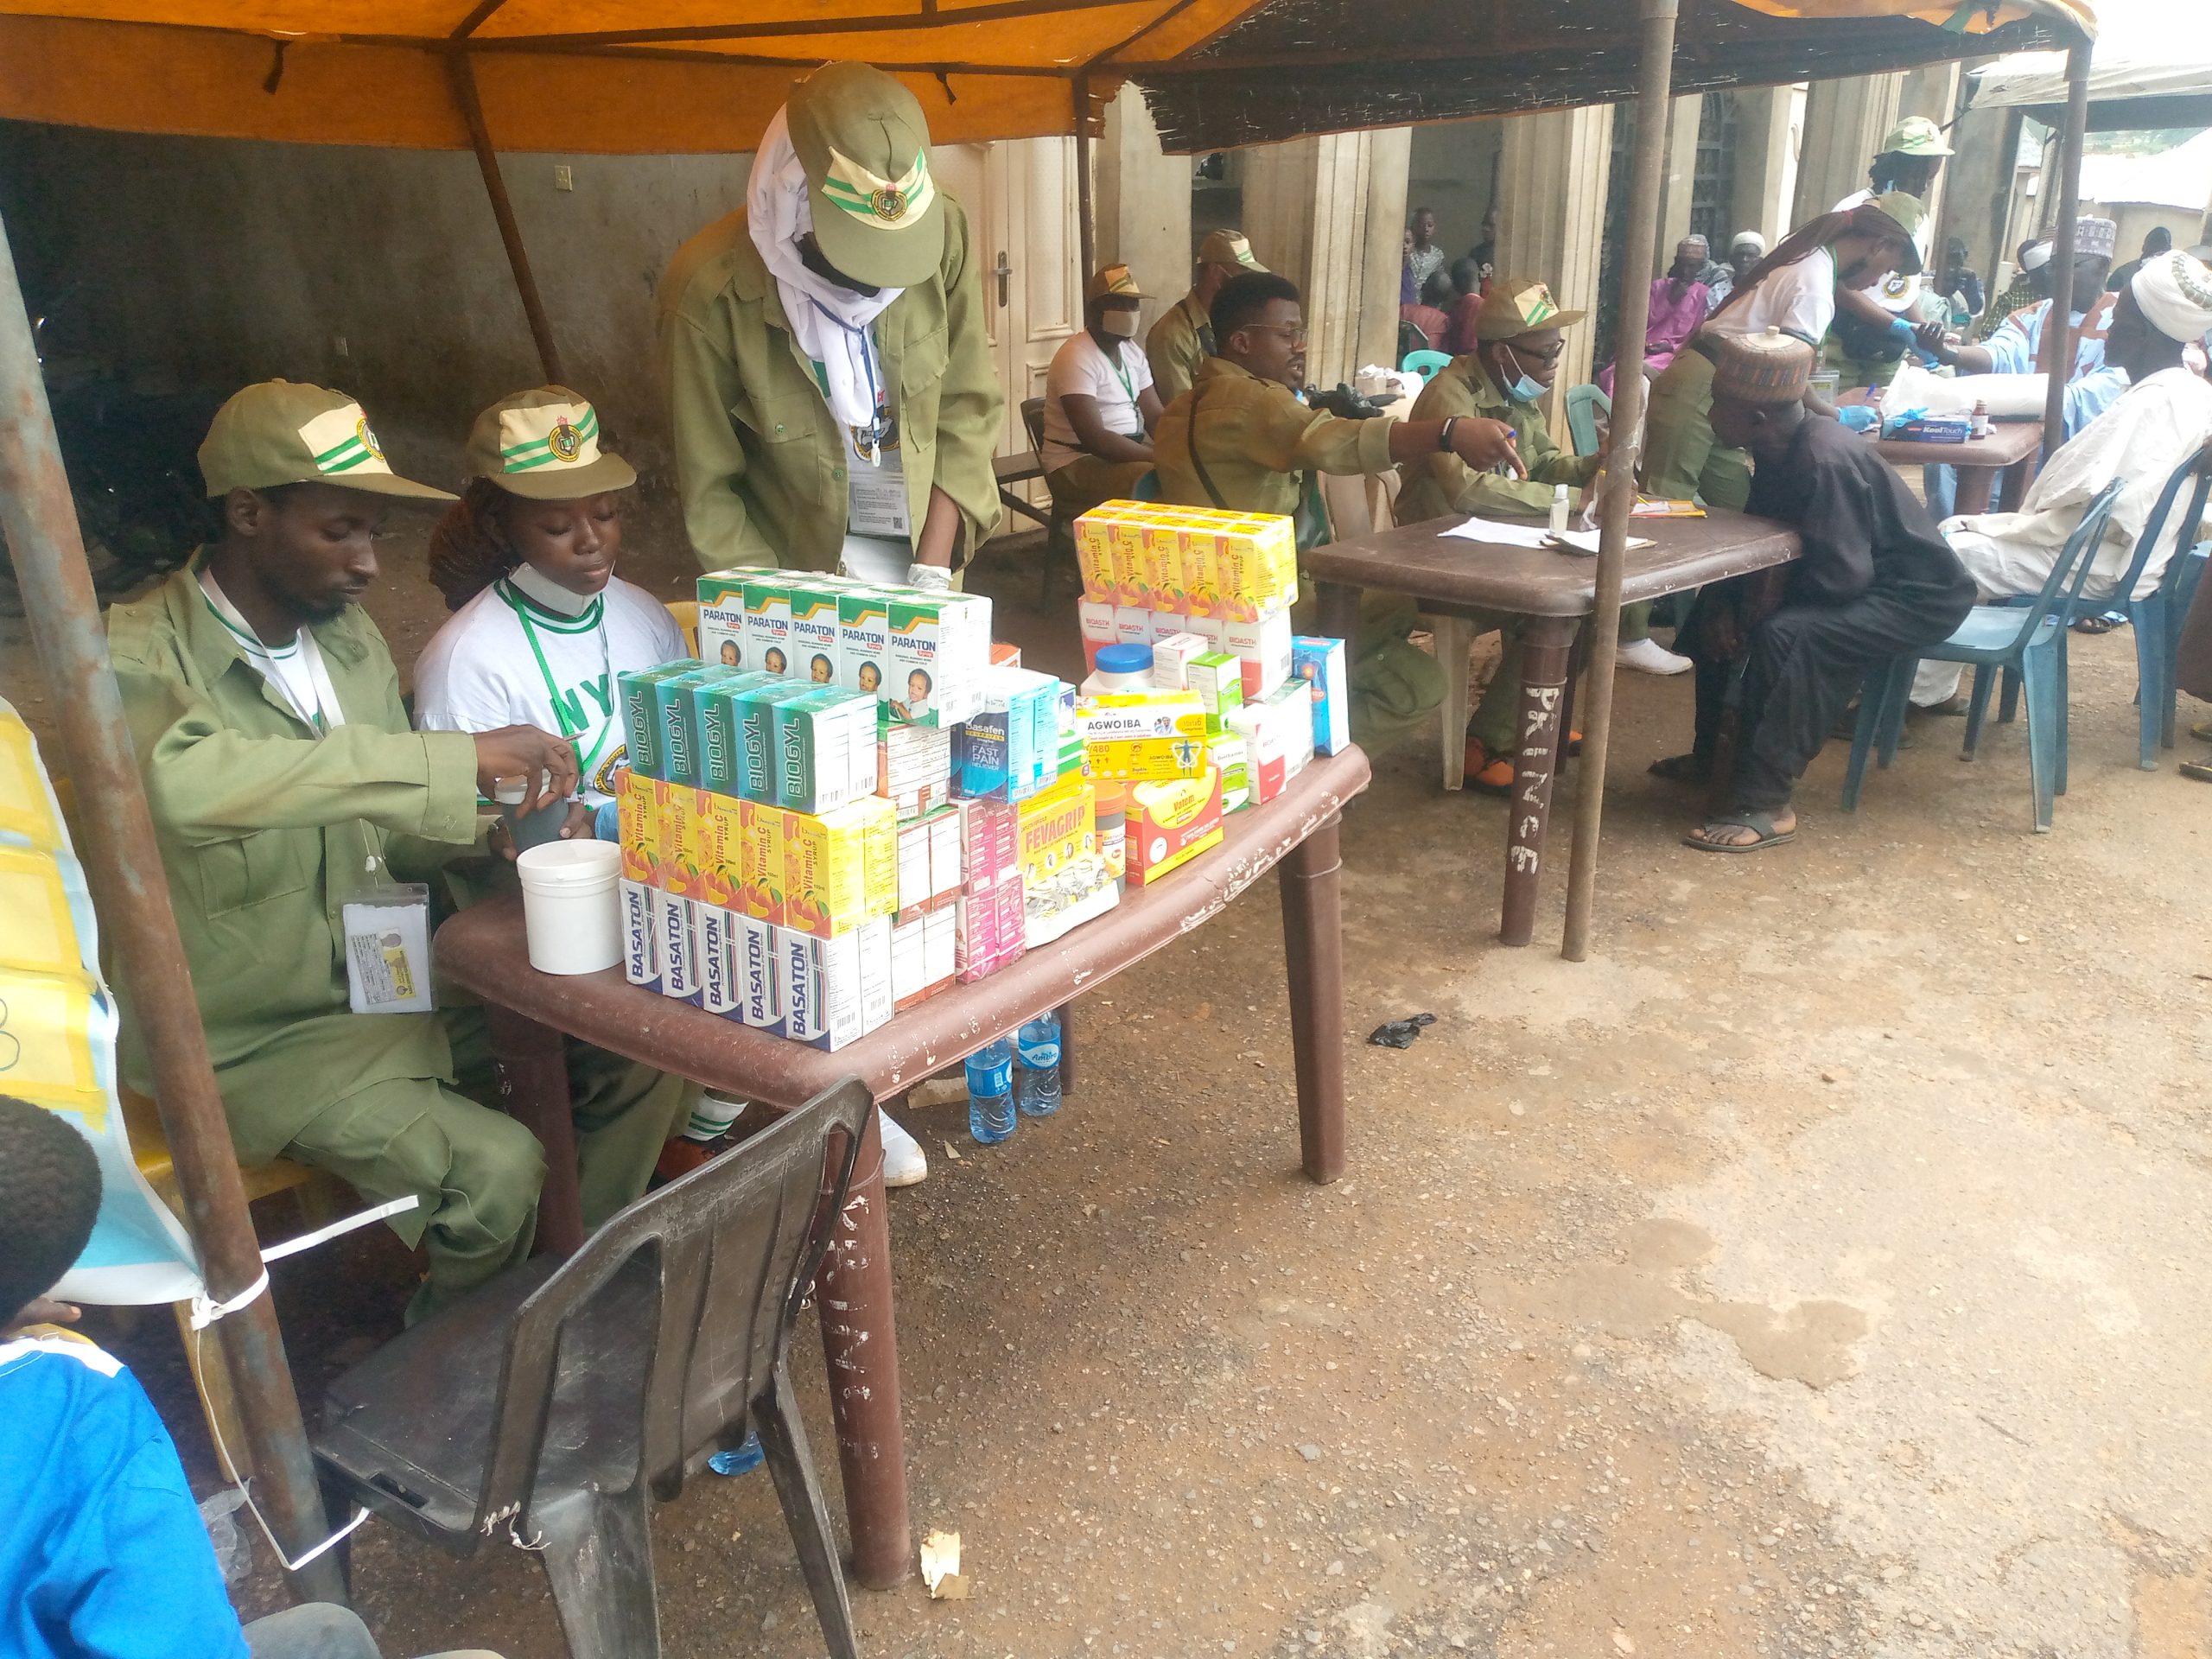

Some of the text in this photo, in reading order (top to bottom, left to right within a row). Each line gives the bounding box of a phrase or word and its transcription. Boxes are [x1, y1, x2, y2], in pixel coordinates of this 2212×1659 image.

[704, 609, 742, 624] PARATON
[747, 616, 788, 631] PARATON
[794, 621, 835, 638] PARATON
[842, 628, 884, 645] PARATON
[1085, 618, 1110, 626] BIOASTH
[1119, 623, 1144, 632] BIOASTH
[892, 635, 936, 652] PARATON
[1230, 636, 1256, 645] BIOASTH
[629, 690, 652, 766] BIOGYL
[665, 698, 689, 776] BIOGYL
[704, 703, 726, 781] BIOGYL
[742, 712, 766, 791] BIOGYL
[784, 718, 804, 798] BIOGYL
[972, 745, 999, 758] FAST
[972, 754, 1000, 766] PAIN
[635, 804, 645, 842] Vitamin
[1026, 806, 1085, 854] FEVAGRIP
[715, 825, 724, 865] Vitamin
[757, 826, 767, 877] Vitamin C
[803, 850, 814, 889] Vitamin
[627, 891, 644, 978] BASATON
[667, 902, 684, 991] BASATON
[706, 916, 722, 1007] BASATON
[747, 929, 765, 1020] BASATON
[791, 942, 806, 1035] BASATON
